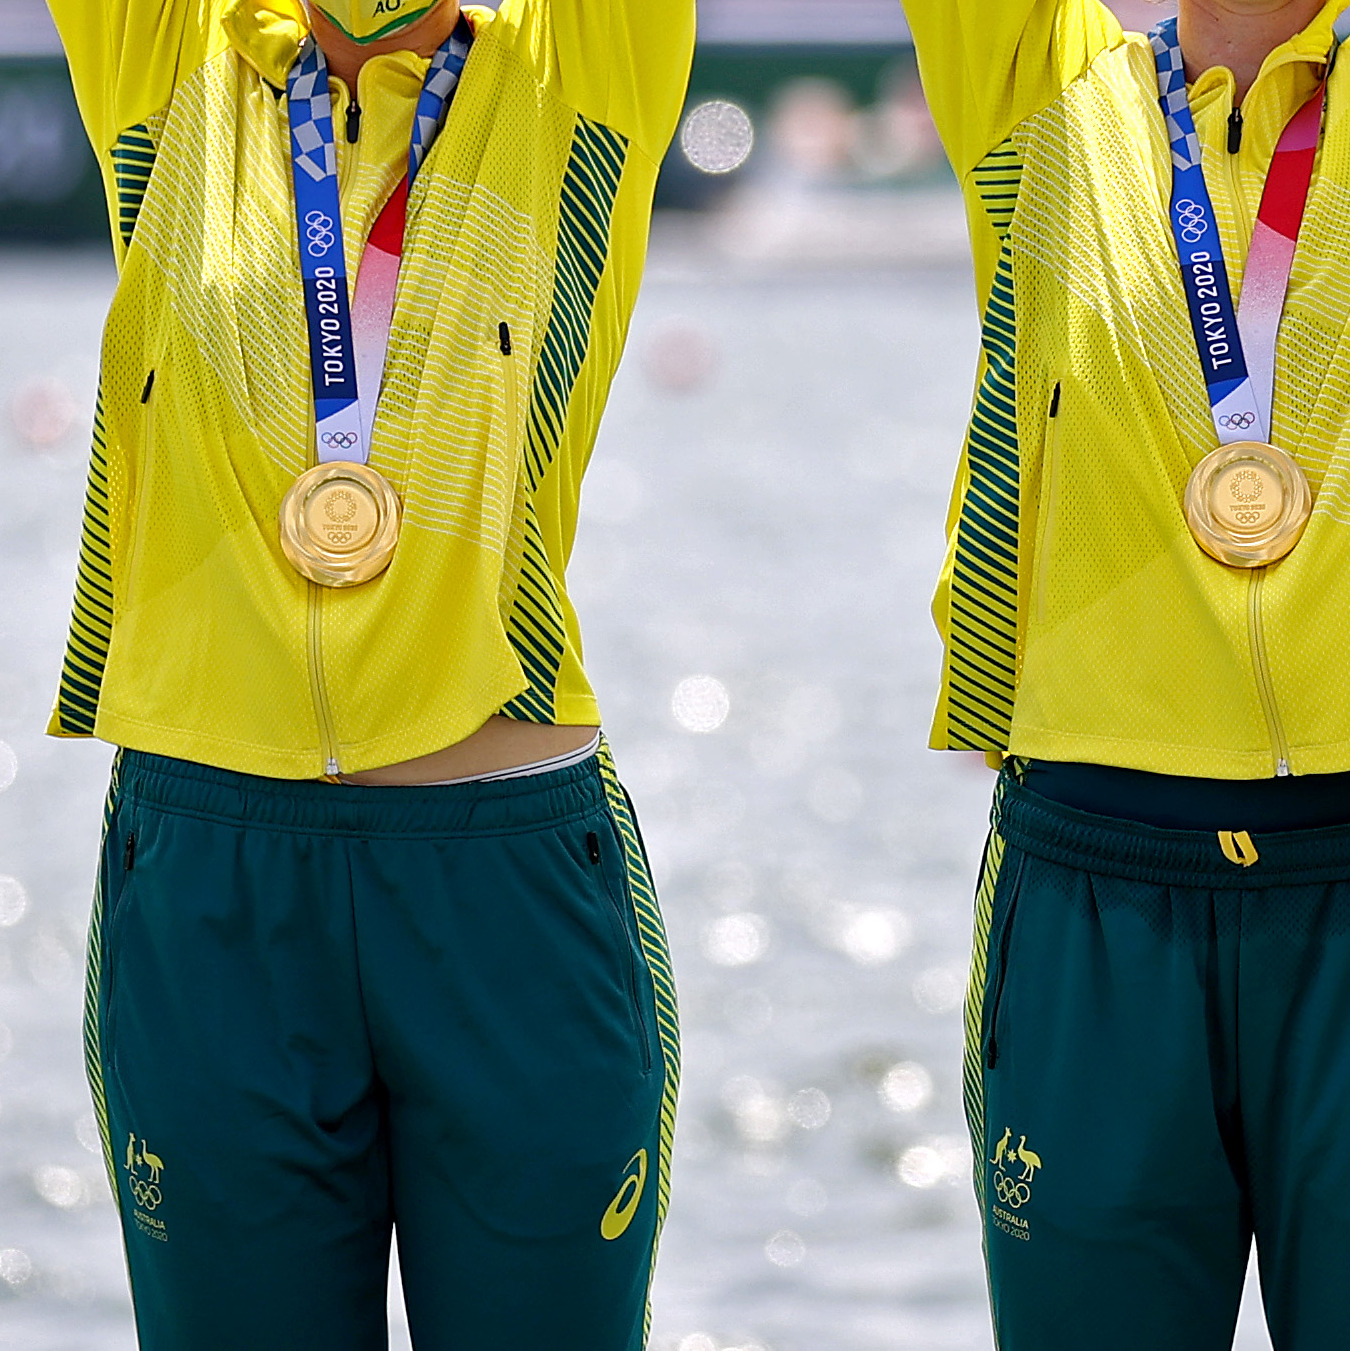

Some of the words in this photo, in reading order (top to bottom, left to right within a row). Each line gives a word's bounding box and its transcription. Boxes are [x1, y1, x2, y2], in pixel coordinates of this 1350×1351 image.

[314, 266, 339, 315] 2020
[1190, 251, 1218, 299] 2020
[320, 318, 345, 387] TOKYO
[1200, 302, 1232, 371] TOKYO
[992, 1204, 1029, 1230] AUSTRALIA
[1010, 1226, 1030, 1241] 2020
